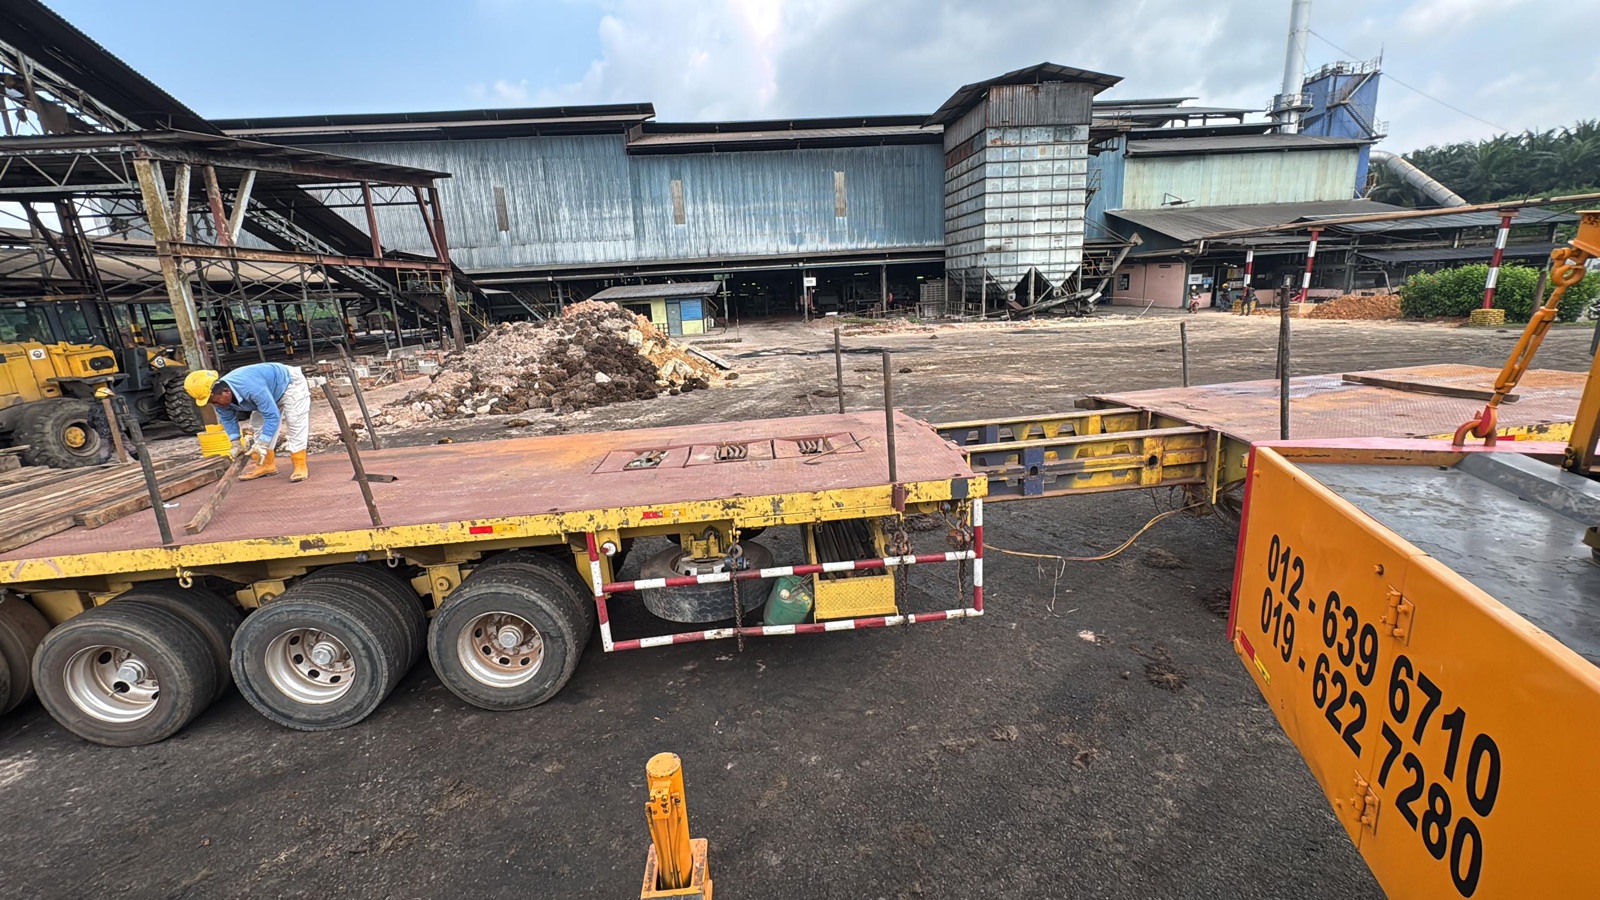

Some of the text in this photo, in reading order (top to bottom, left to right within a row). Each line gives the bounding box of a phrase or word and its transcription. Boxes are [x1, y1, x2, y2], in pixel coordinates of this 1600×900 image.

[1261, 587, 1295, 663] 019
[1312, 653, 1367, 759] 622
[1377, 721, 1483, 899] 7280
[1267, 534, 1305, 612] 012
[1322, 590, 1379, 687] 639
[1388, 654, 1501, 818] 6710
